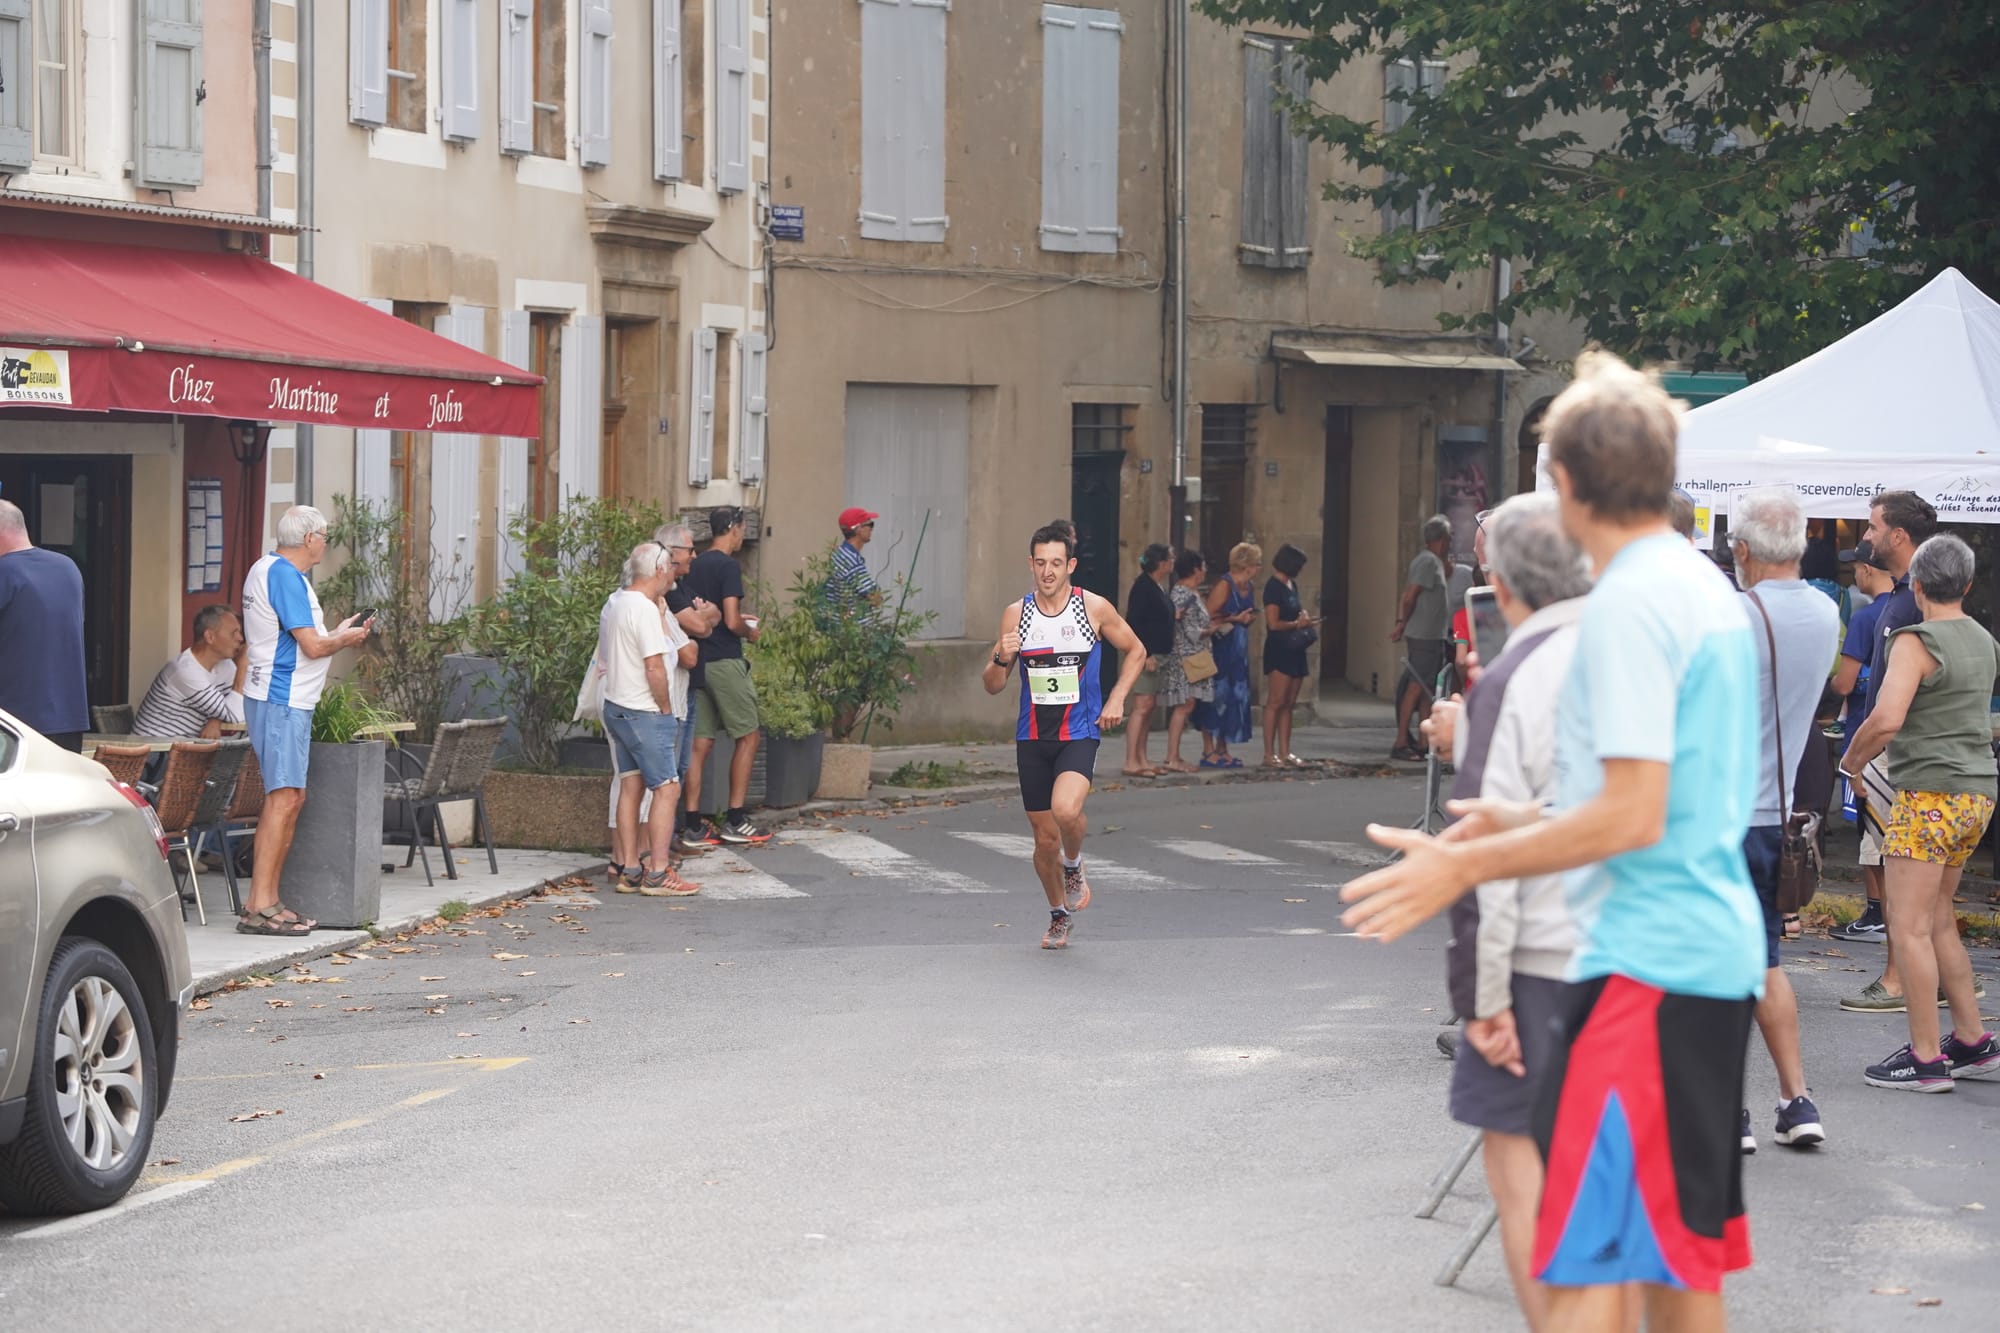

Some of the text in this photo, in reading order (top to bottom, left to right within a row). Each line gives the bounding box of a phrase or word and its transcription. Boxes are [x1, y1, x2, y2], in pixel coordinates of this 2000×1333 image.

[7, 390, 64, 401] BOISSONS
[169, 364, 463, 428] Chez Martine et John
[1935, 493, 1981, 505] Challenge
[1934, 502, 2000, 513] allées cévenole
[1047, 677, 1059, 693] 3
[1890, 1066, 1917, 1079] HOKA
